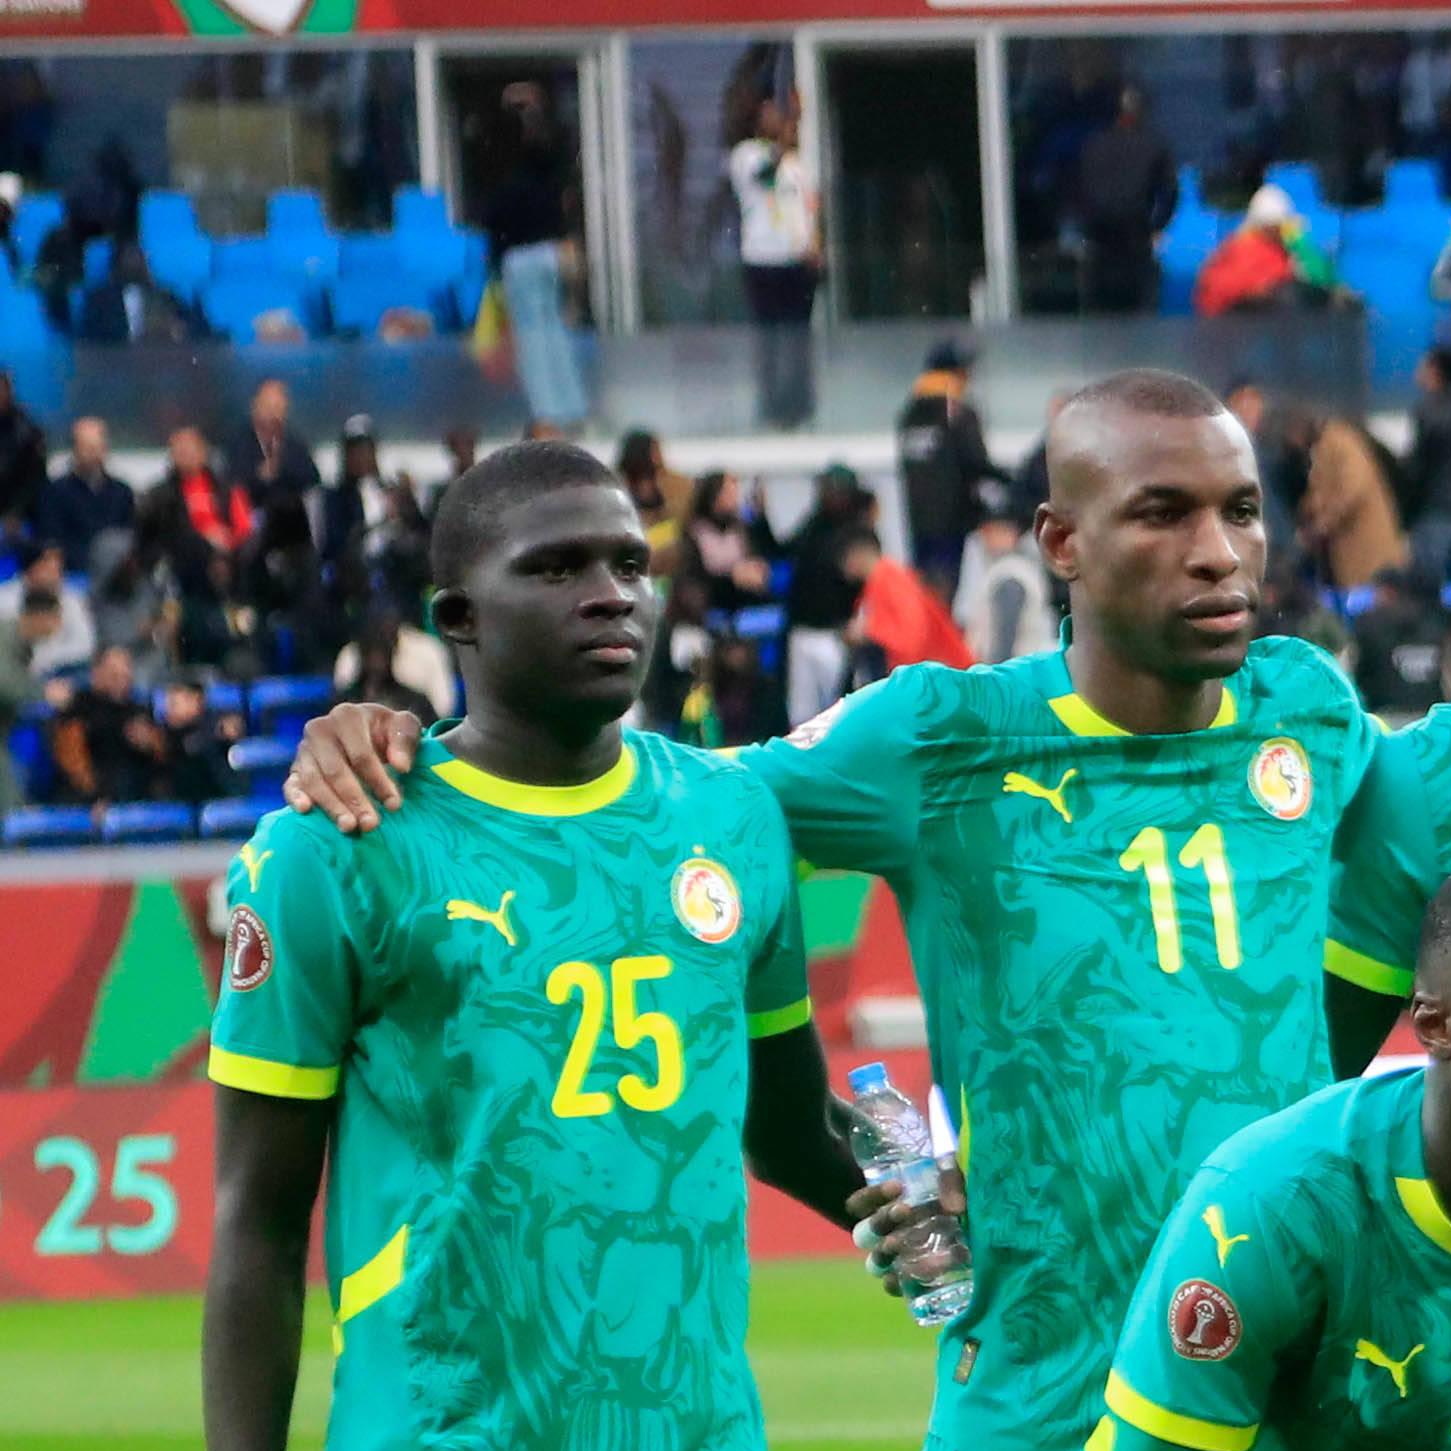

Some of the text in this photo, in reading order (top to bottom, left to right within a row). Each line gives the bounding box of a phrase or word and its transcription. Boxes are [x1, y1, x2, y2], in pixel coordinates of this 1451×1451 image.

[1118, 823, 1243, 974] 11
[545, 955, 684, 1118] 25
[34, 1134, 179, 1255] 25
